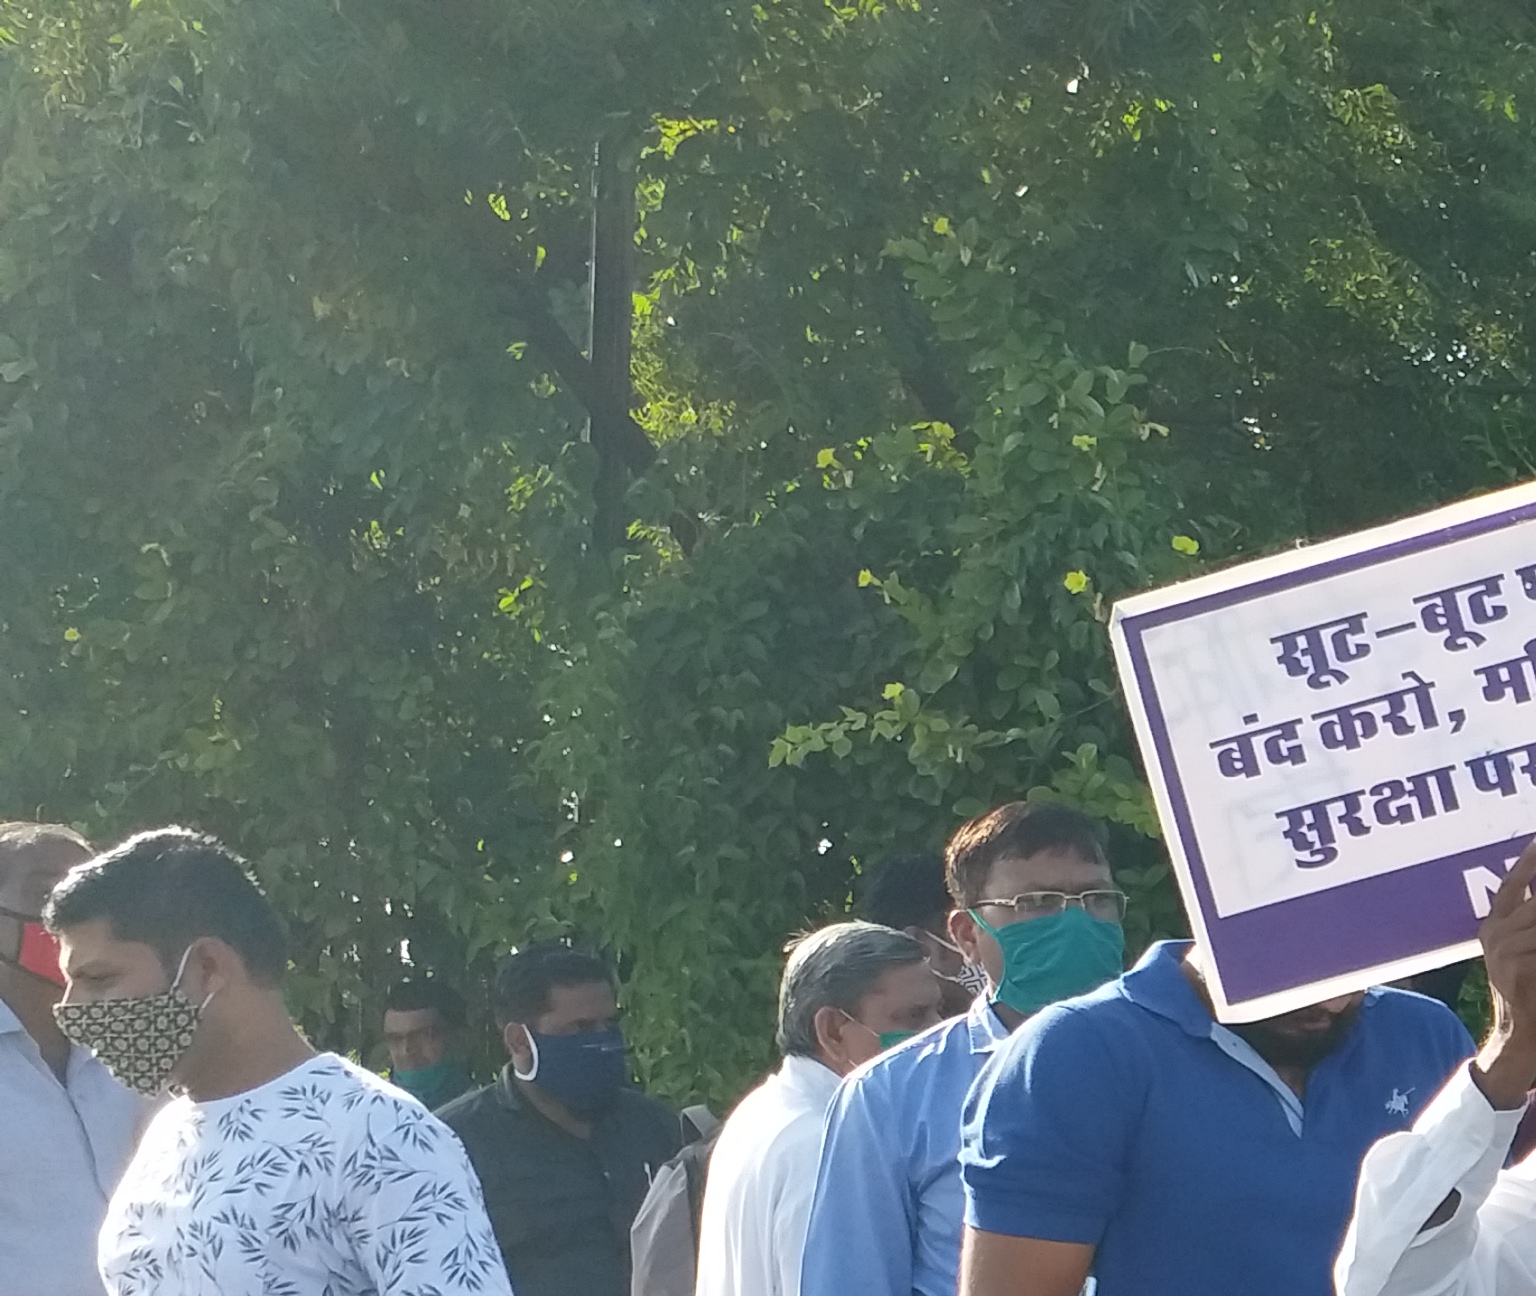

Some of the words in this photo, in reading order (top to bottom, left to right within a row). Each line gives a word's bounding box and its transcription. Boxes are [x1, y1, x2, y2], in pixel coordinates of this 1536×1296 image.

[1210, 712, 1307, 779] बंद
[1317, 671, 1467, 752] करो,
[1276, 764, 1458, 867] सुरक्षा
